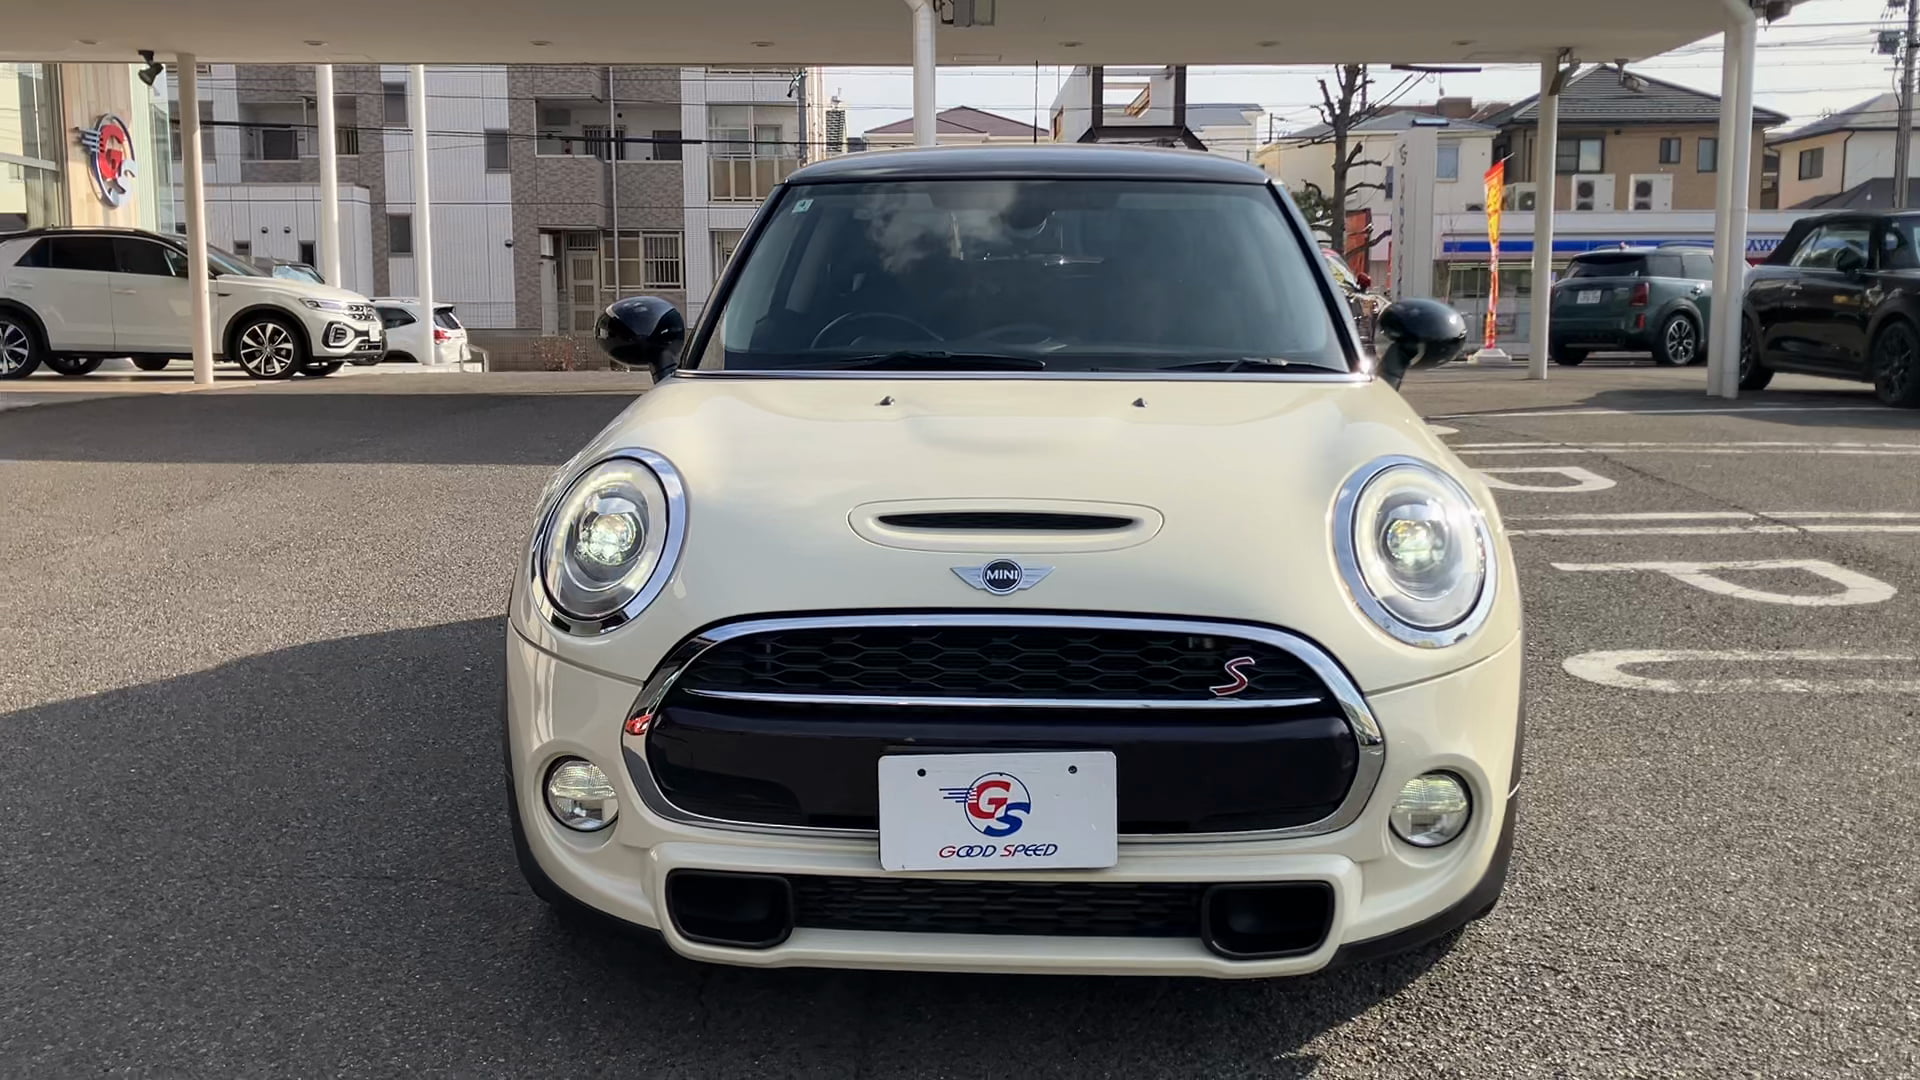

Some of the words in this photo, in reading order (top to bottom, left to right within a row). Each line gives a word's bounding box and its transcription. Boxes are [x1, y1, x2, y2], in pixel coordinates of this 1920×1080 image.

[986, 569, 1019, 580] MINI
[1208, 655, 1256, 696] S
[966, 779, 1032, 838] GS
[939, 844, 997, 859] GOOD
[1000, 843, 1058, 858] SPEED
